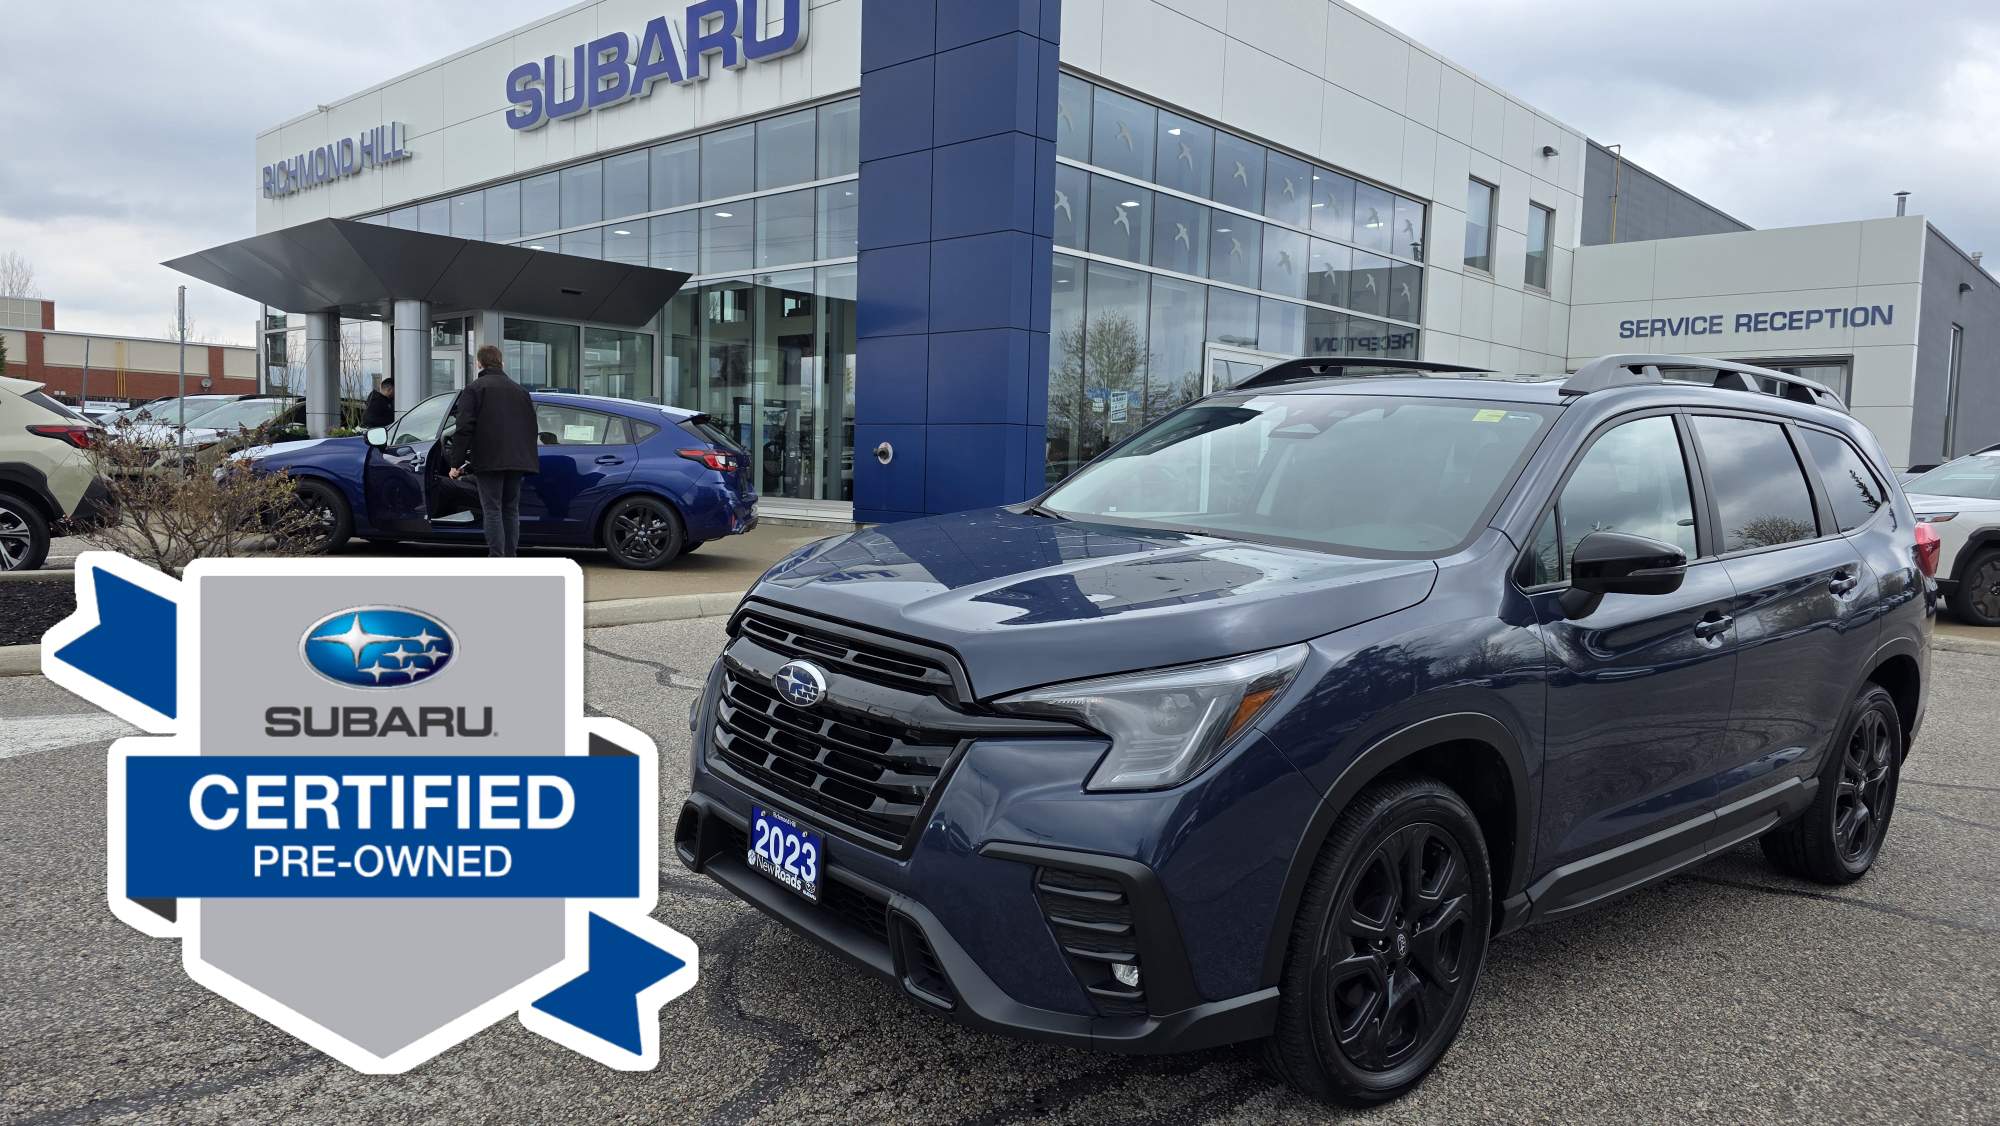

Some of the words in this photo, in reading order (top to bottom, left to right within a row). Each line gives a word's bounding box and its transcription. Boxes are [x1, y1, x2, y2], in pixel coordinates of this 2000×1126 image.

[505, 0, 803, 130] SUBARU
[263, 138, 355, 198] RICHMOND
[361, 121, 405, 168] HILL
[1619, 315, 1723, 338] SERVICE
[1735, 305, 1894, 333] RECEPTION
[755, 818, 816, 882] 2023
